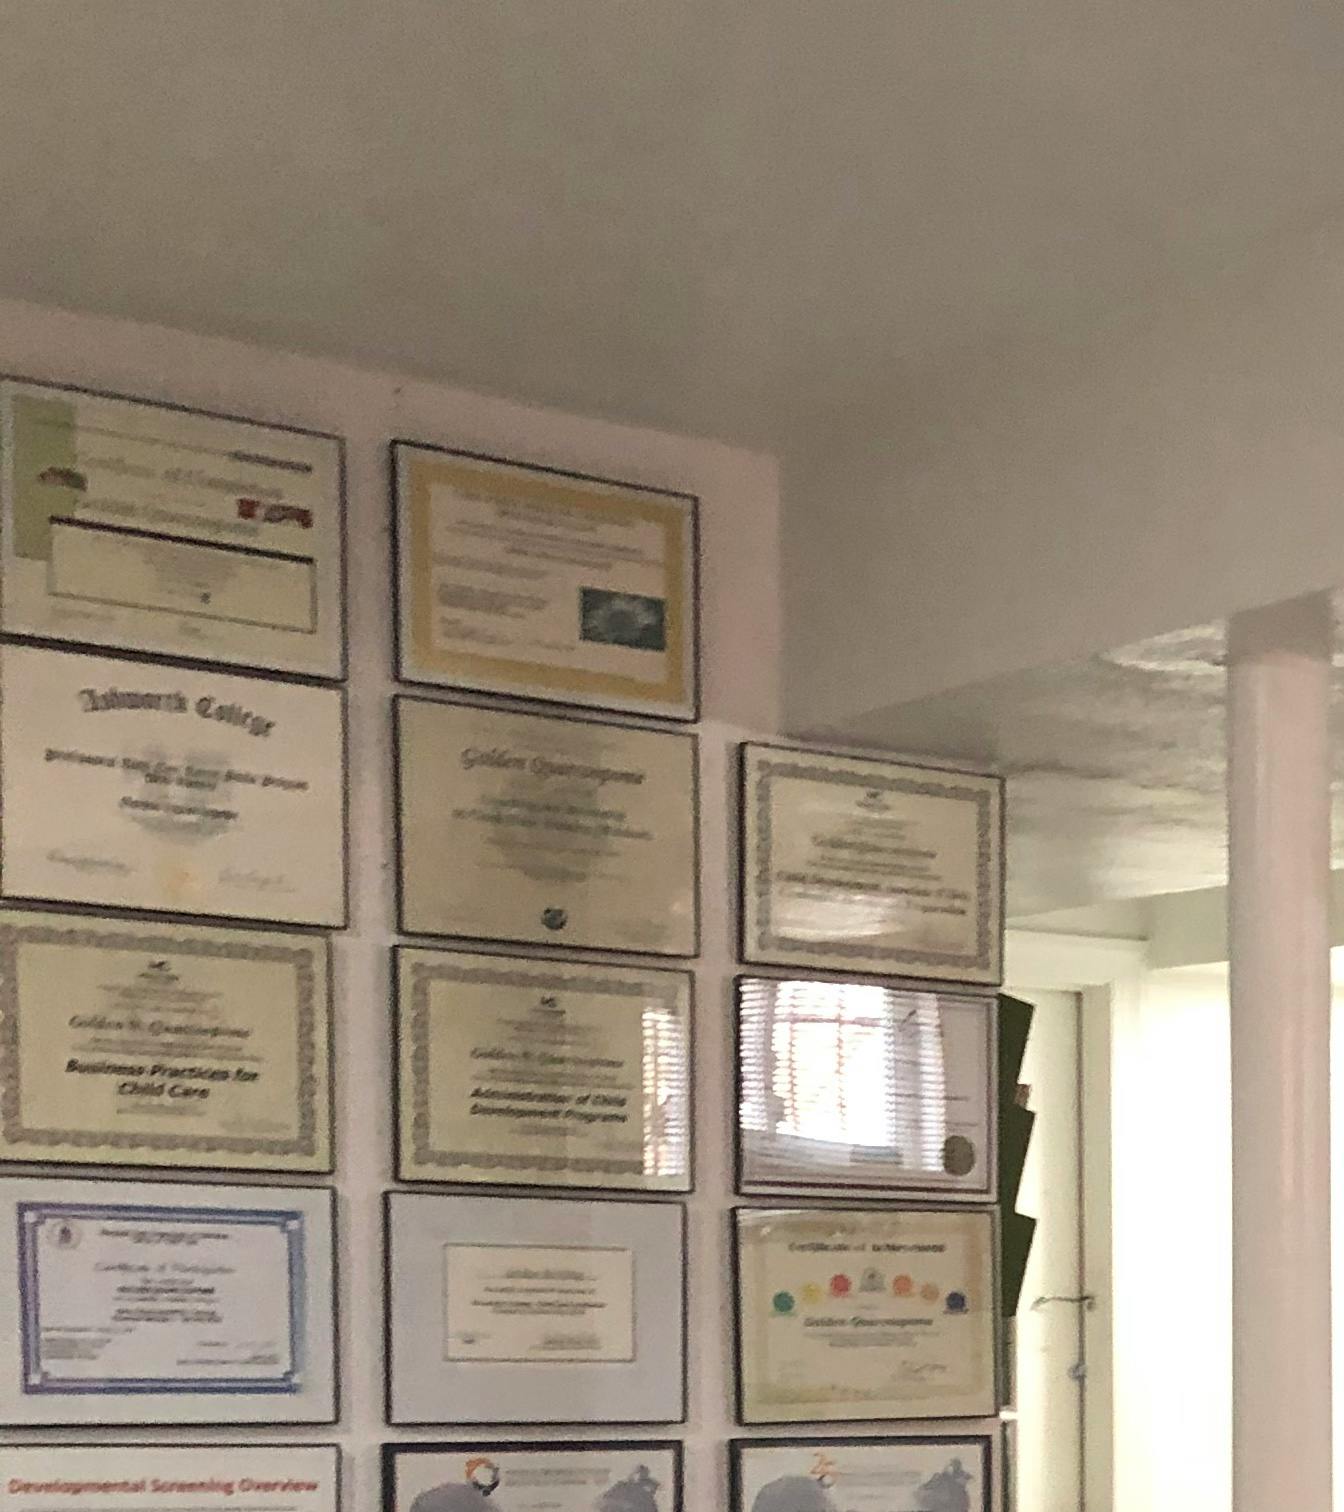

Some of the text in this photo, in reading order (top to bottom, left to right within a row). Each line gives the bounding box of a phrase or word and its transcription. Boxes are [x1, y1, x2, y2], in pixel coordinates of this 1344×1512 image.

[194, 695, 276, 737] College
[65, 1057, 260, 1083] Business Practices for
[118, 1081, 211, 1099] Child Care
[8, 1477, 318, 1496] Developmental Screening Overview
